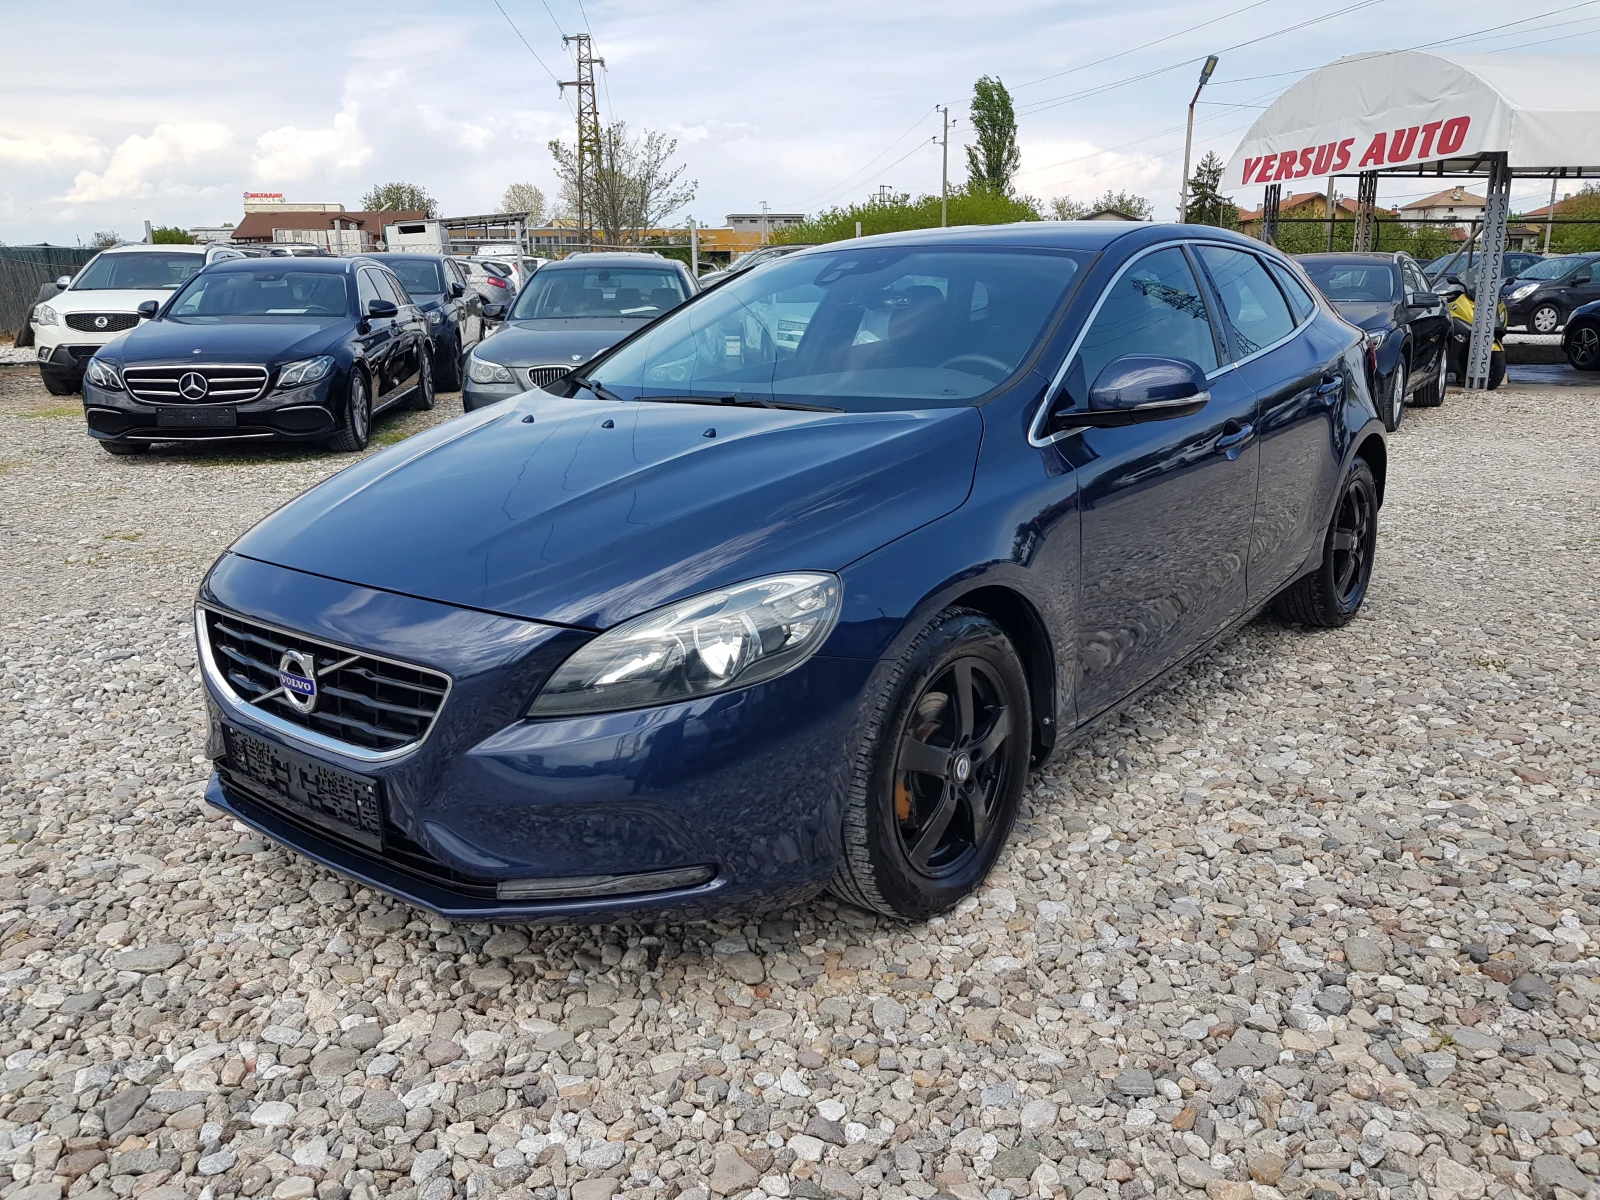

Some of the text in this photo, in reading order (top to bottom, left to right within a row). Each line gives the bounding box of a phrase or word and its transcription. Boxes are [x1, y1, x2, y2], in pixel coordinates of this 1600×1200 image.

[1242, 116, 1471, 185] VERSUS AUTO
[281, 673, 312, 691] VOLVO
